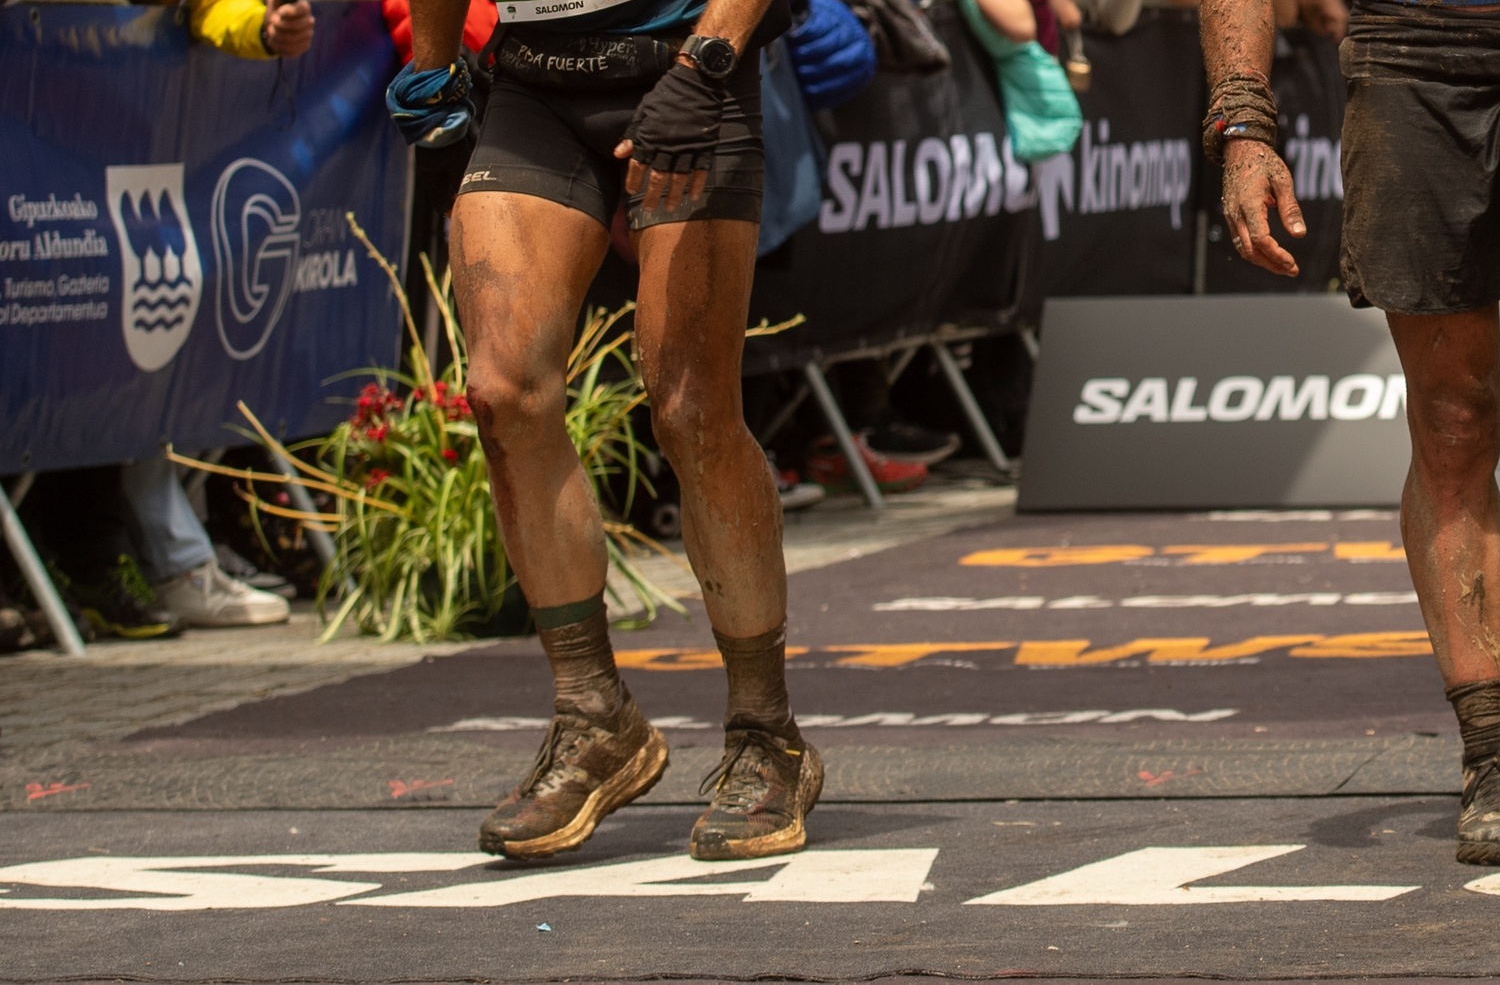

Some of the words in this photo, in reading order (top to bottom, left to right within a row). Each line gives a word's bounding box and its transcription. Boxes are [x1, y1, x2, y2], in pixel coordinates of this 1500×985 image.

[535, 0, 585, 15] SALOMON
[546, 56, 609, 72] FUERTE
[1079, 119, 1192, 231] kinomap
[8, 193, 98, 227] Gipuzkoako
[33, 229, 109, 259] Aldundia
